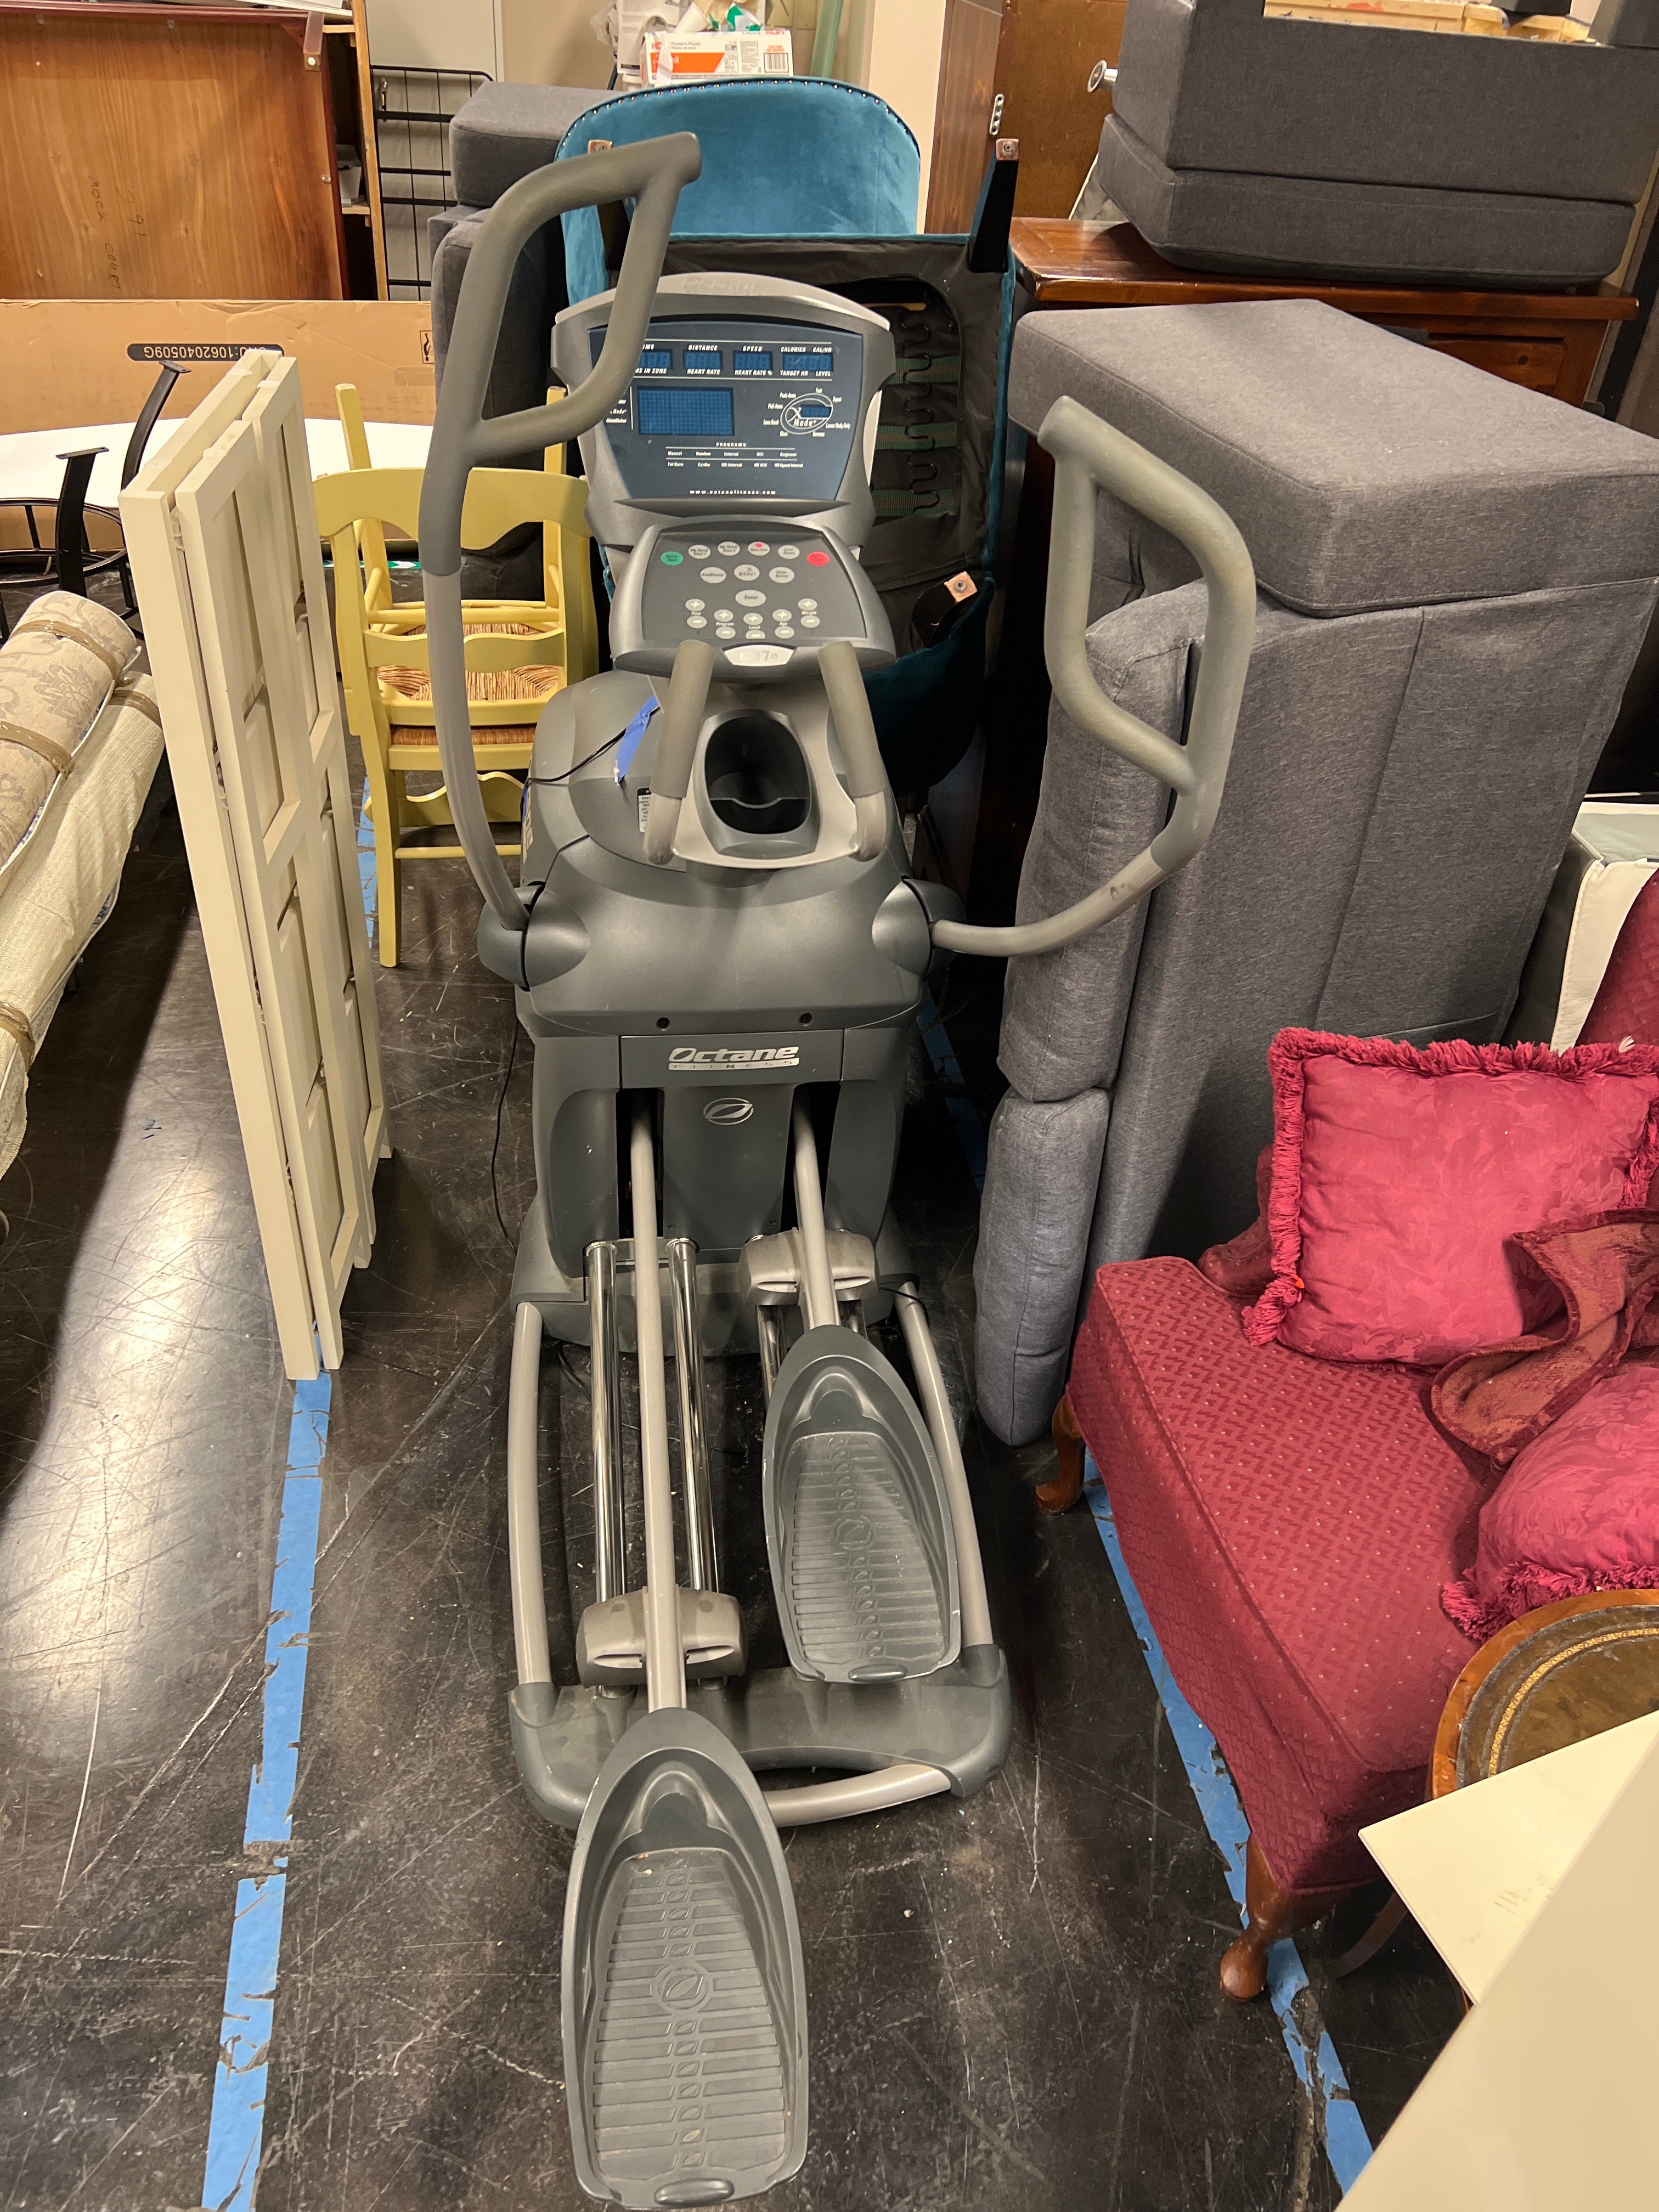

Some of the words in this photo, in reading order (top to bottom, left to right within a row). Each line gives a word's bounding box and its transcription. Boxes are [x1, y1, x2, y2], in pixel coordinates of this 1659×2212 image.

[88, 176, 108, 222] MOCK
[143, 346, 267, 359] U:1062040509G
[668, 1046, 799, 1063] Octane
